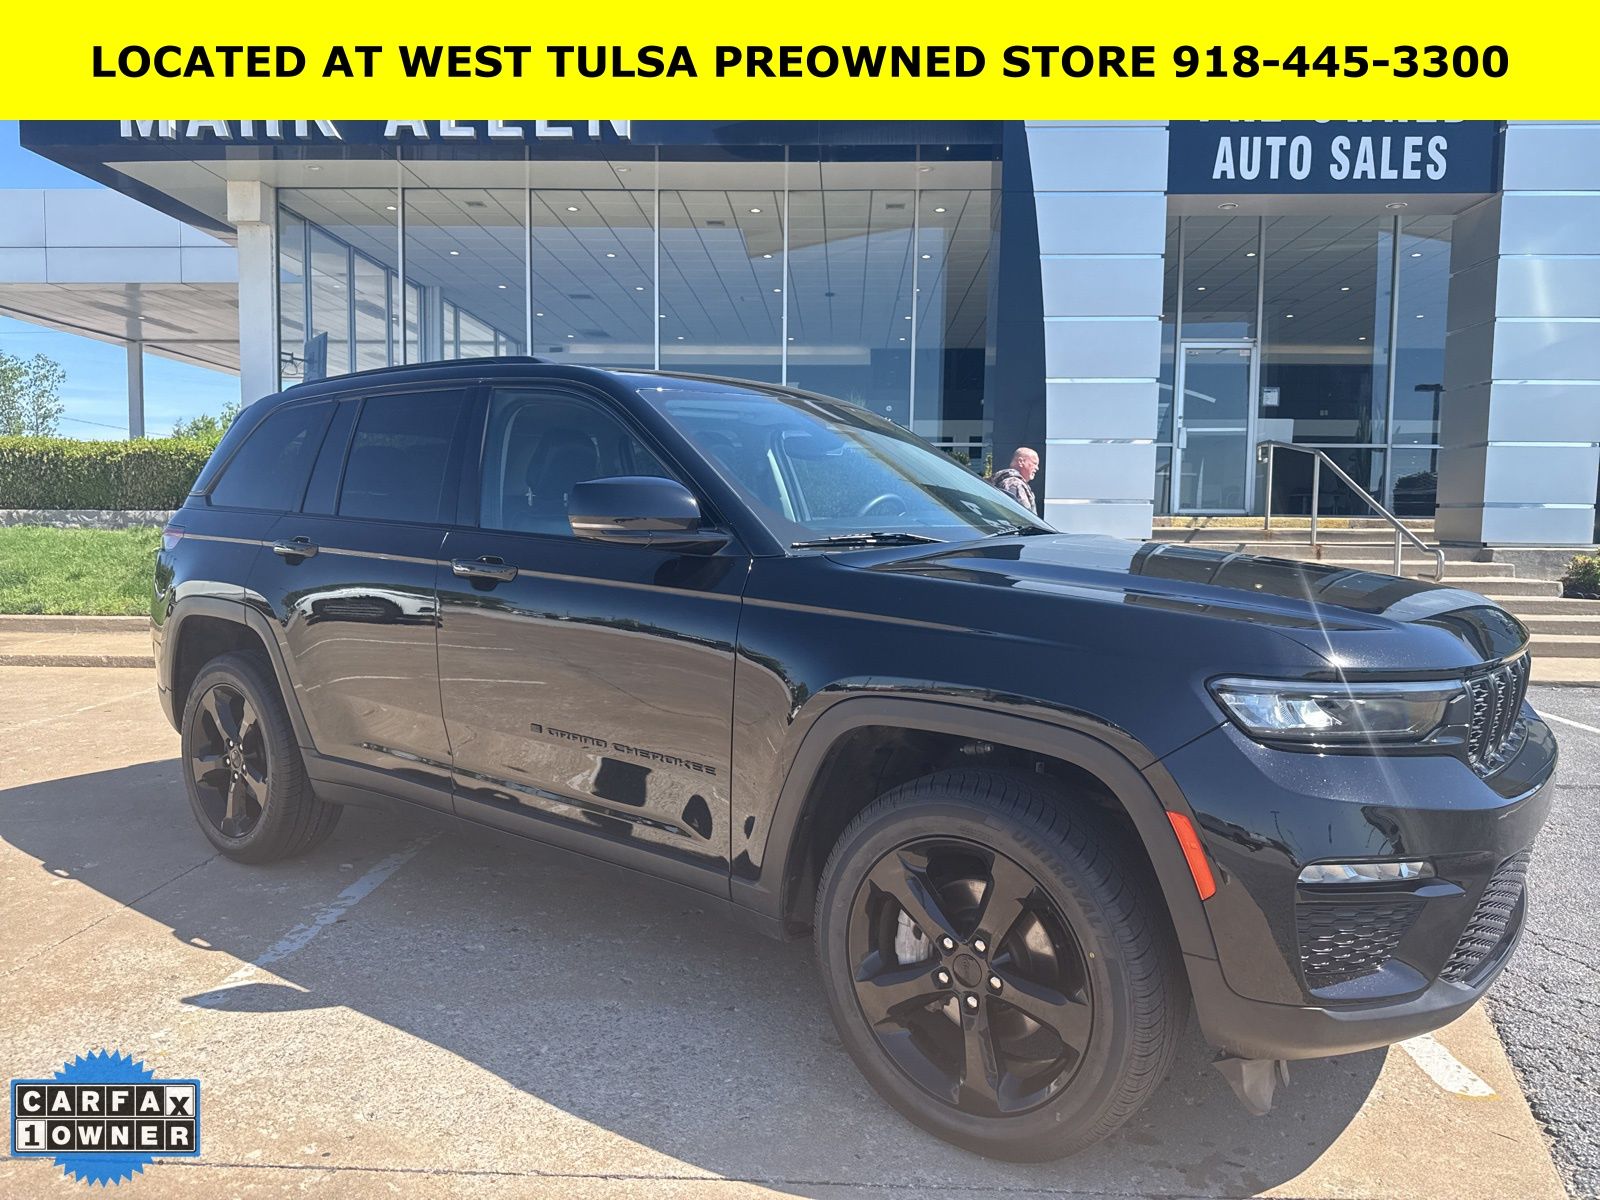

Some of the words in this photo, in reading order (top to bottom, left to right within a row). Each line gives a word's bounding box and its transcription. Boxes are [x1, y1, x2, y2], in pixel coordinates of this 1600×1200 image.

[1212, 135, 1312, 180] AUTO
[1329, 135, 1448, 180] SALES
[547, 727, 608, 748] GRAND
[611, 742, 717, 776] CHEROKEE
